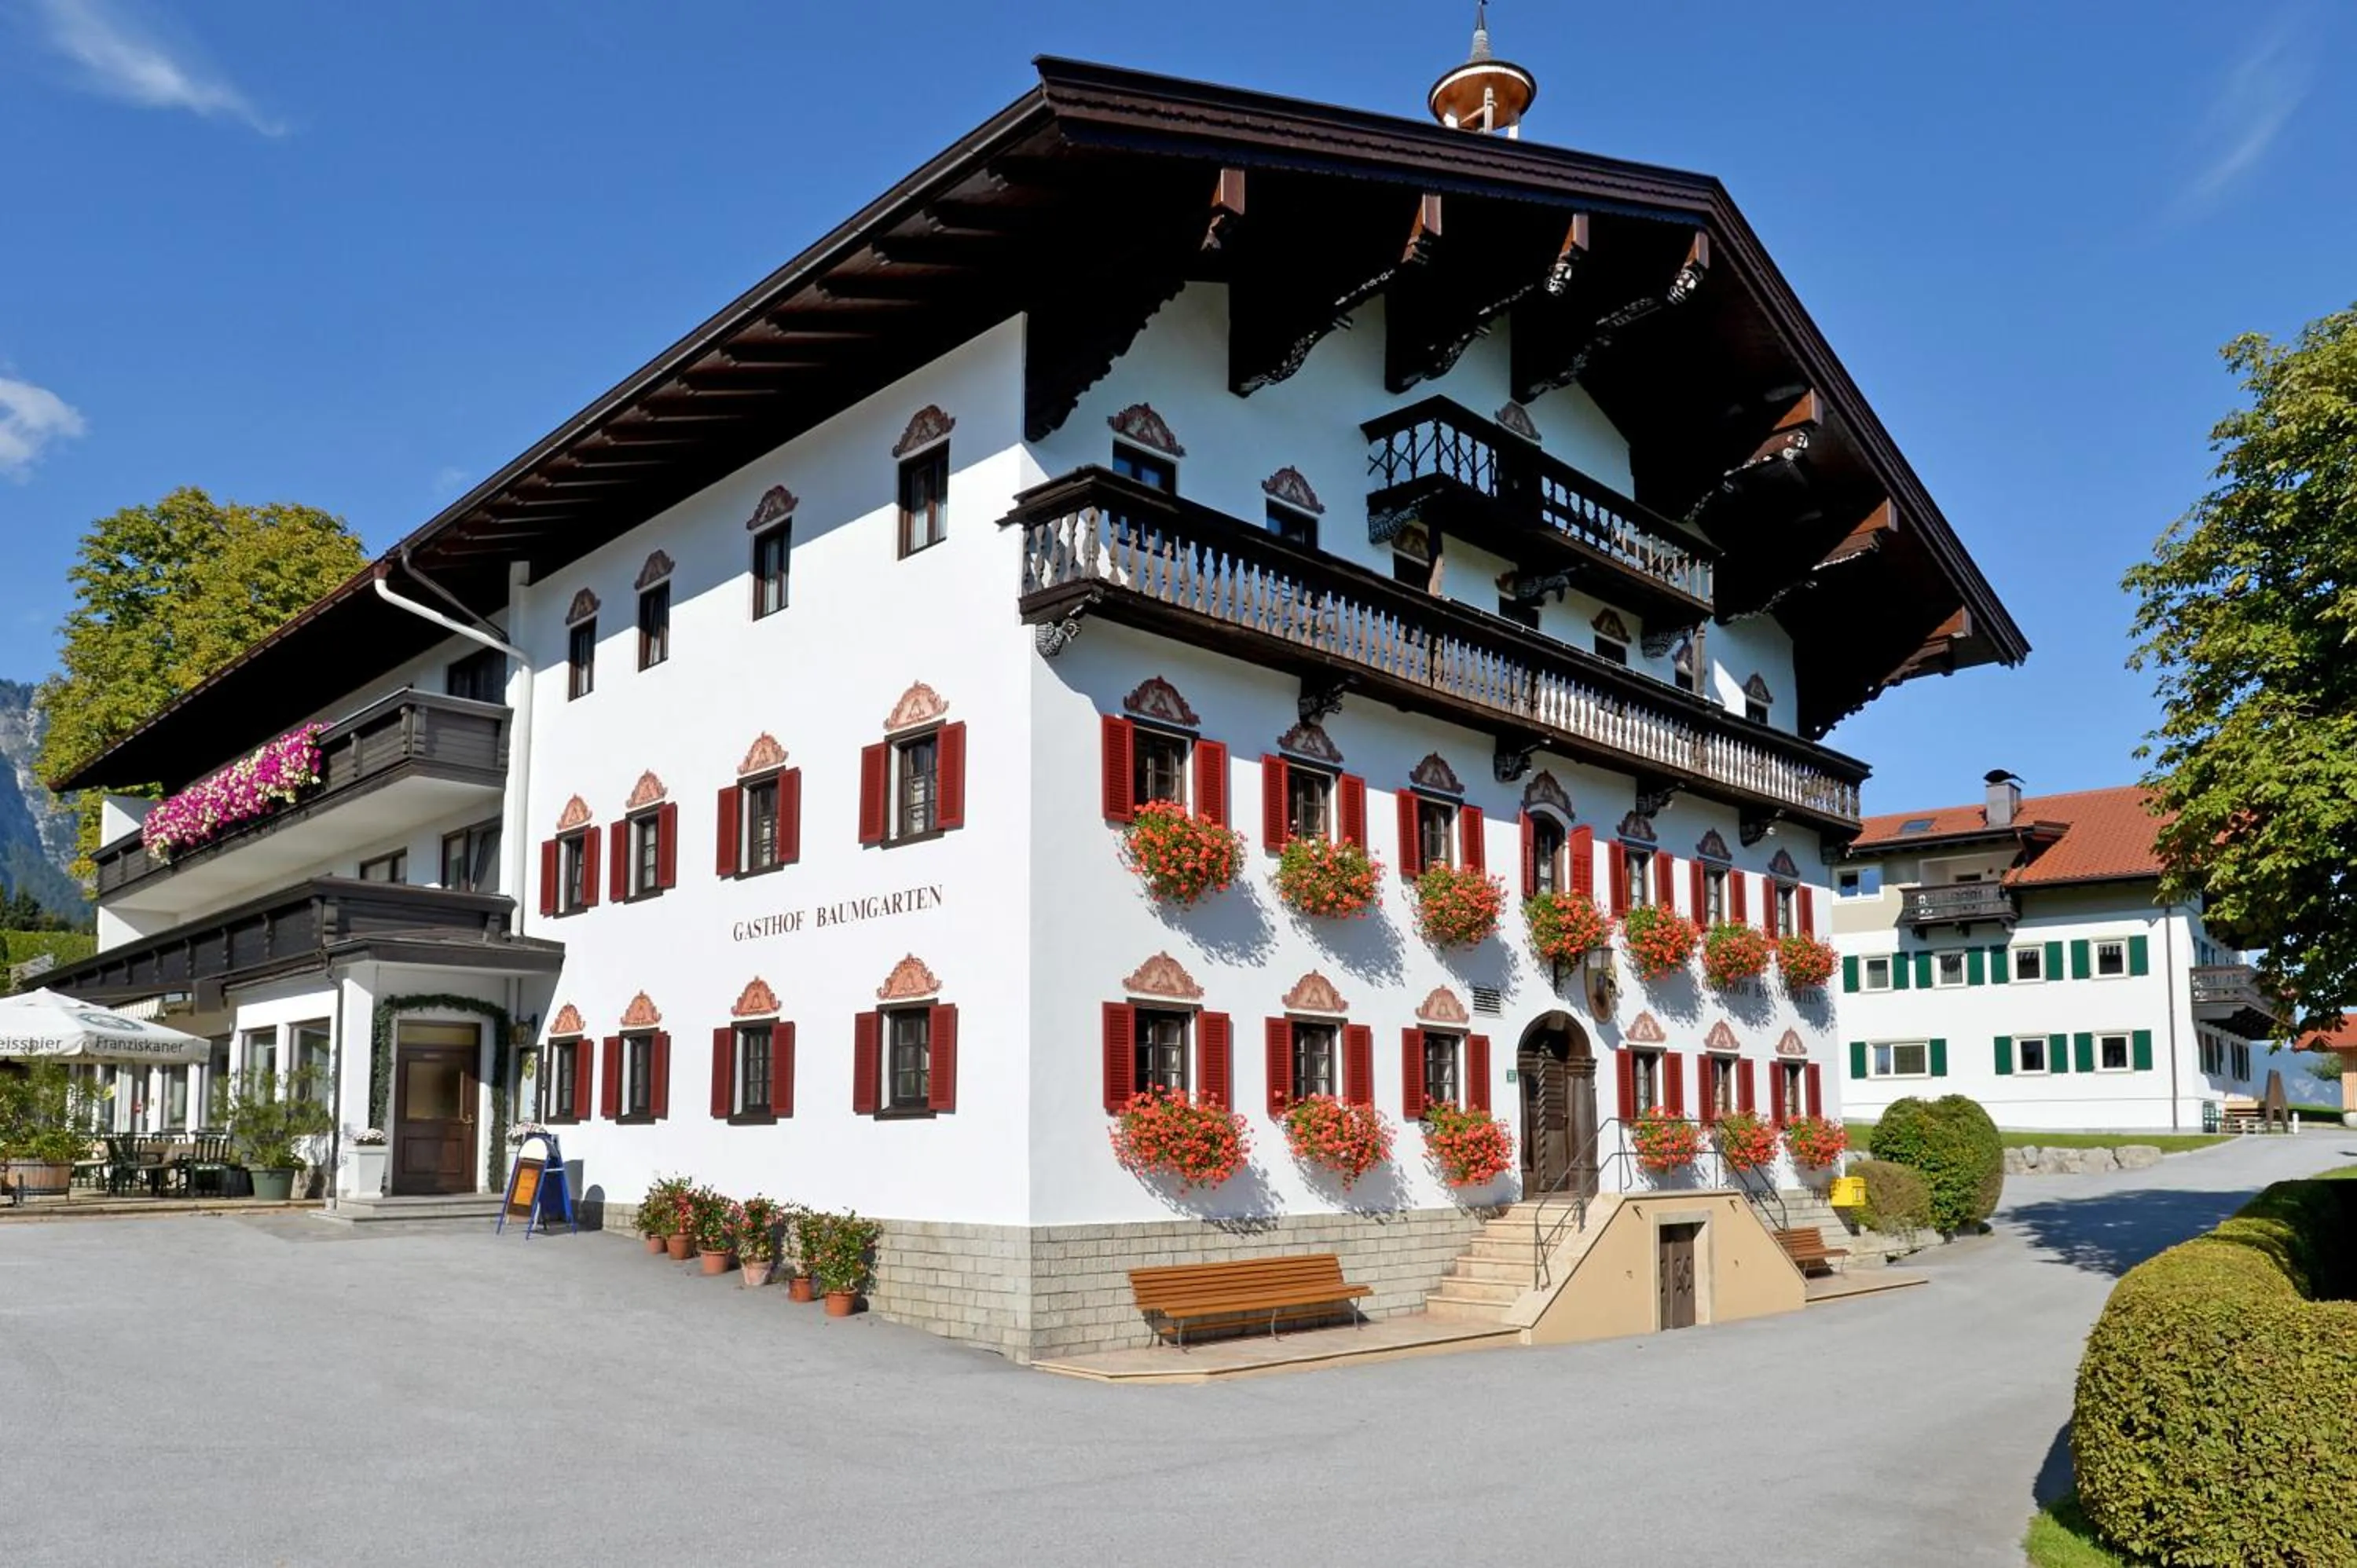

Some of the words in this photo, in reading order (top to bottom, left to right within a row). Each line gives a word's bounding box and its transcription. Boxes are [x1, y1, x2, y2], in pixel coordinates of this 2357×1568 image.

[733, 910, 805, 942] GASTHOF
[816, 884, 943, 928] BAUMGARTEN
[94, 1035, 185, 1053] Franziskaner
